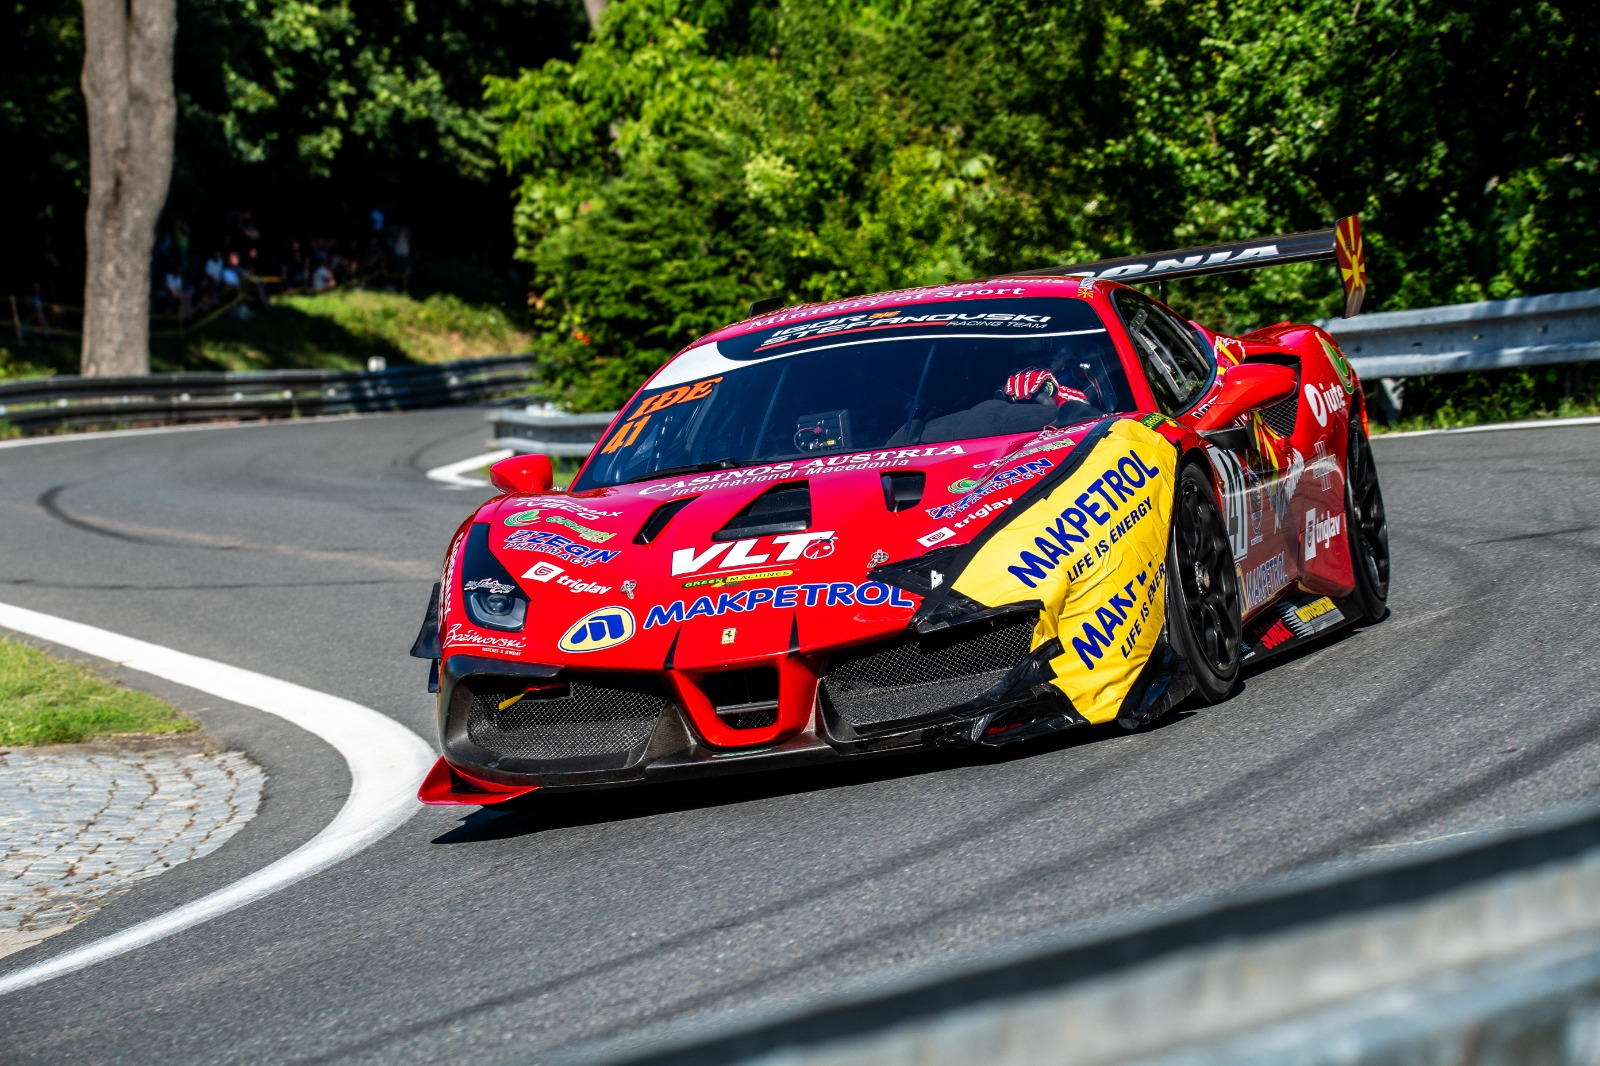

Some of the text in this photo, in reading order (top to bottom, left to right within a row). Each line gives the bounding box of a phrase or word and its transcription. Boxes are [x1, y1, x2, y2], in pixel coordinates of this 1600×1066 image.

[1064, 244, 1279, 279] ONIA
[745, 298, 886, 330] Ministry
[893, 291, 926, 302] of
[933, 286, 1026, 300] Sport
[1006, 321, 1048, 329] TEAM
[600, 414, 652, 455] 41
[638, 461, 793, 496] CASINOS
[798, 443, 967, 471] AUSTRIA
[671, 458, 910, 497] International Macedonia
[953, 497, 1014, 530] triglav
[1006, 449, 1161, 589] MAKPETROL
[1315, 510, 1341, 549] triglav
[502, 541, 597, 568] PHARMACY
[670, 530, 836, 577] VLT
[1066, 496, 1153, 584] LIFE IS ENERGY
[556, 575, 613, 595] triglav
[684, 577, 724, 589] GREEN
[728, 570, 791, 582] MACHINES
[642, 581, 914, 630] MAKPETROL
[1120, 618, 1143, 660] LIFE
[1139, 601, 1151, 624] IS
